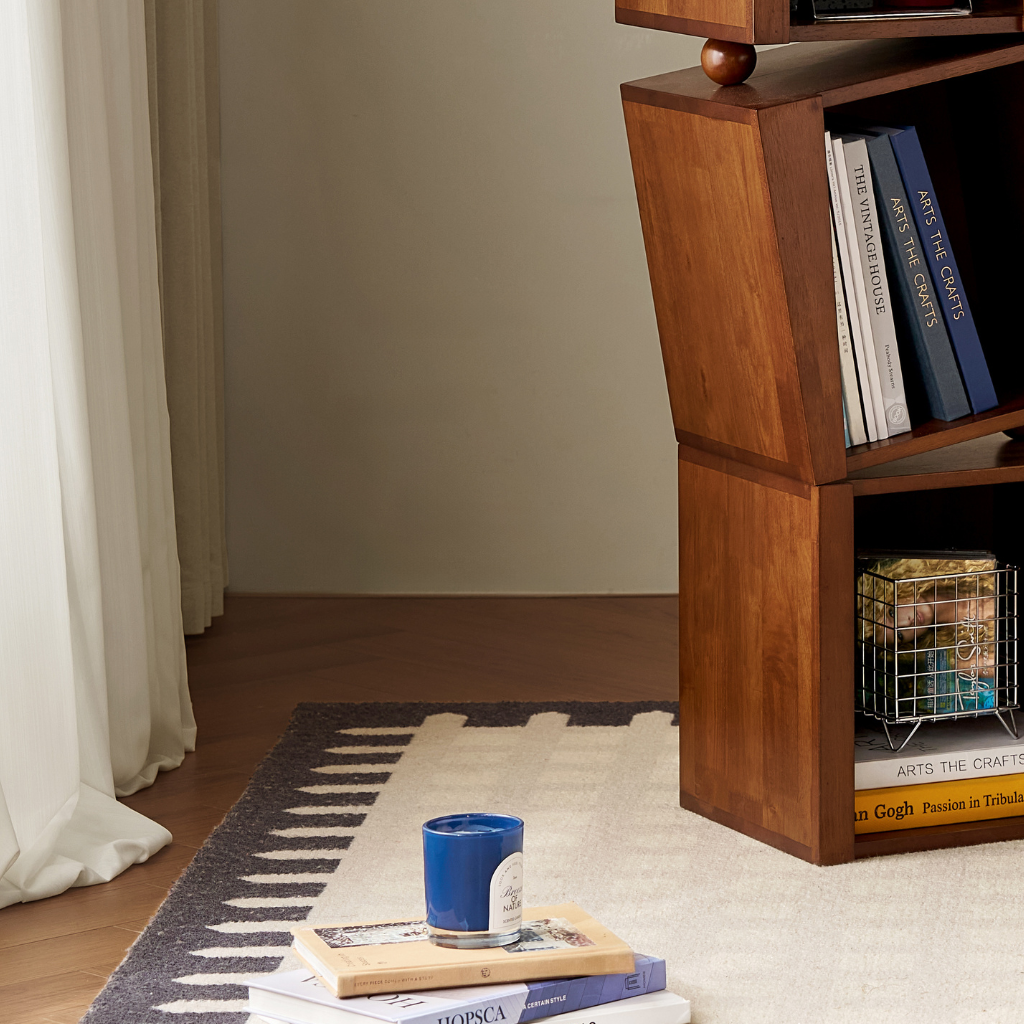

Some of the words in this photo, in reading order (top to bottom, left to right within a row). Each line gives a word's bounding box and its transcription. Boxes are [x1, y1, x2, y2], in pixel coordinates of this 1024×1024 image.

[854, 164, 868, 195] THE
[859, 198, 878, 263] VINTAGE
[890, 198, 910, 233] ARTS
[903, 236, 920, 268] THE
[913, 273, 938, 328] CRAFTS
[917, 190, 937, 226] ARTS
[930, 229, 948, 261] THE
[940, 266, 965, 320] CRAFTS
[869, 264, 886, 316] HOUSE
[897, 762, 934, 778] ARTS
[939, 760, 967, 773] THE
[854, 809, 869, 822] an
[874, 801, 914, 821] Gogh
[922, 799, 966, 814] Passion
[969, 796, 980, 808] in
[503, 900, 522, 913] NATURE
[511, 895, 518, 903] OF
[527, 998, 550, 1010] CERTAIN
[550, 994, 567, 1005] STYLE
